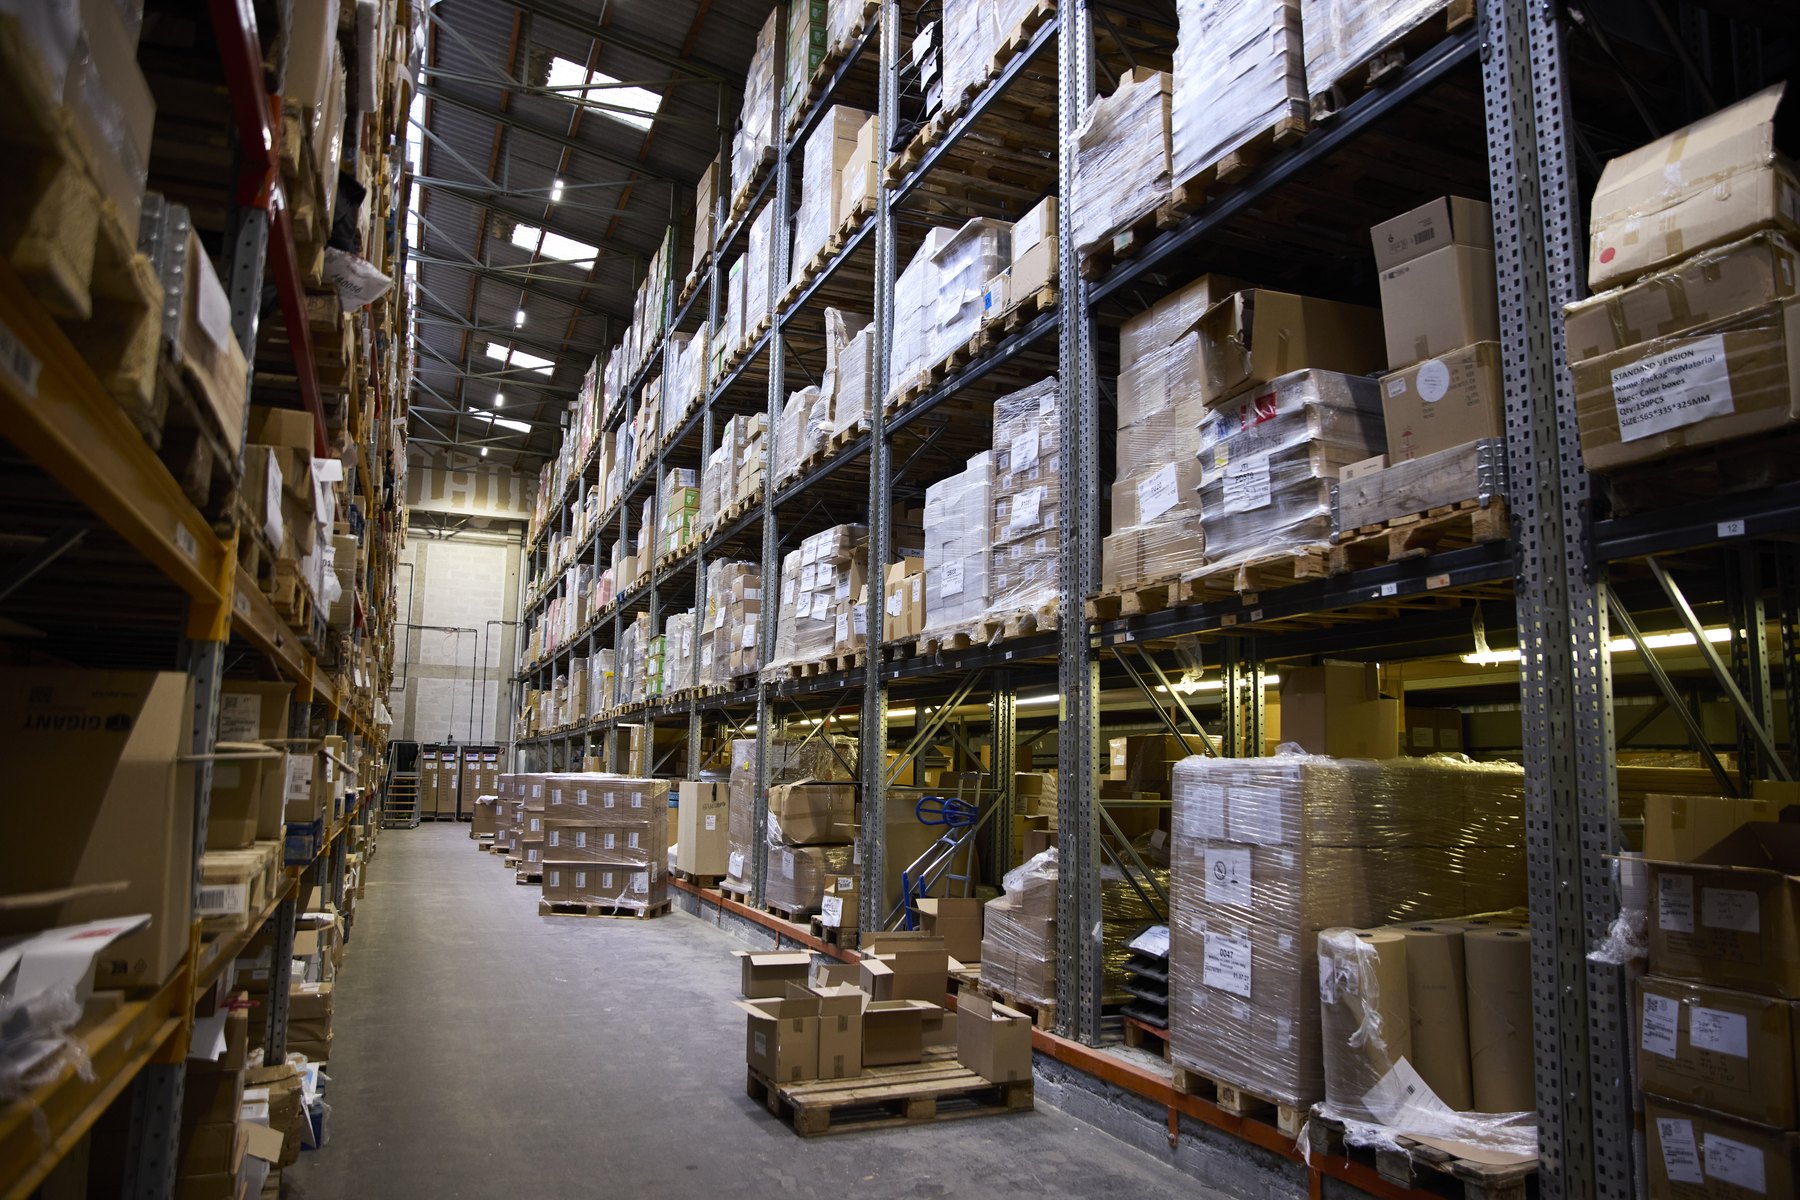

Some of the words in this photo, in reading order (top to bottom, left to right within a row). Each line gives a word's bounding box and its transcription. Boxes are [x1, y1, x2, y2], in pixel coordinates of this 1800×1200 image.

[1657, 349, 1694, 366] VERSION
[1661, 378, 1685, 389] boxes
[1728, 523, 1738, 532] 12
[23, 714, 101, 731] GIGANT
